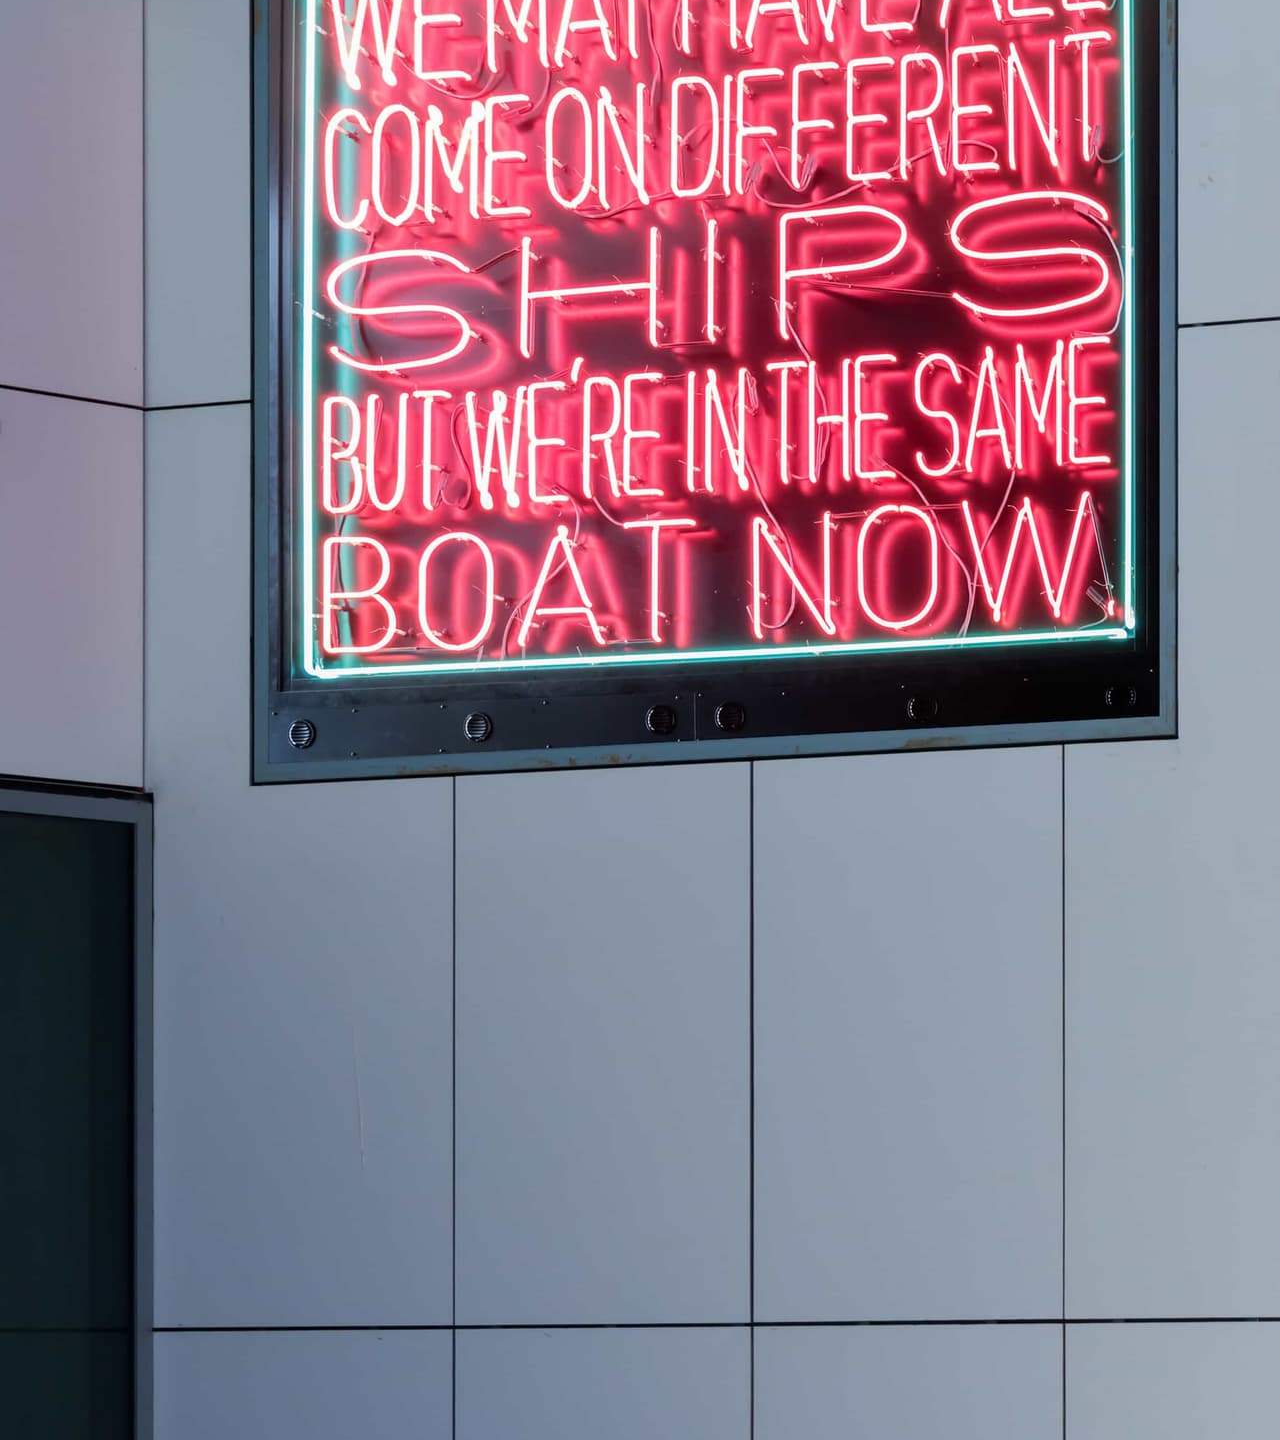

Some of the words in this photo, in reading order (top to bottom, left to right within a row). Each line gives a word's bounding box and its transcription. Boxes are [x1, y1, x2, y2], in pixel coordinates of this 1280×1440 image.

[322, 93, 532, 230] COME
[544, 83, 650, 209] ON
[669, 30, 1113, 200] DIFFERENT
[326, 189, 1112, 373] SHIPS
[319, 389, 447, 515] BUT
[465, 357, 663, 511] WE'RE
[685, 368, 751, 492] IN
[766, 353, 899, 484] THE
[913, 336, 1112, 477] SAME
[319, 518, 697, 655] BOAT
[751, 491, 1093, 639] NOW
